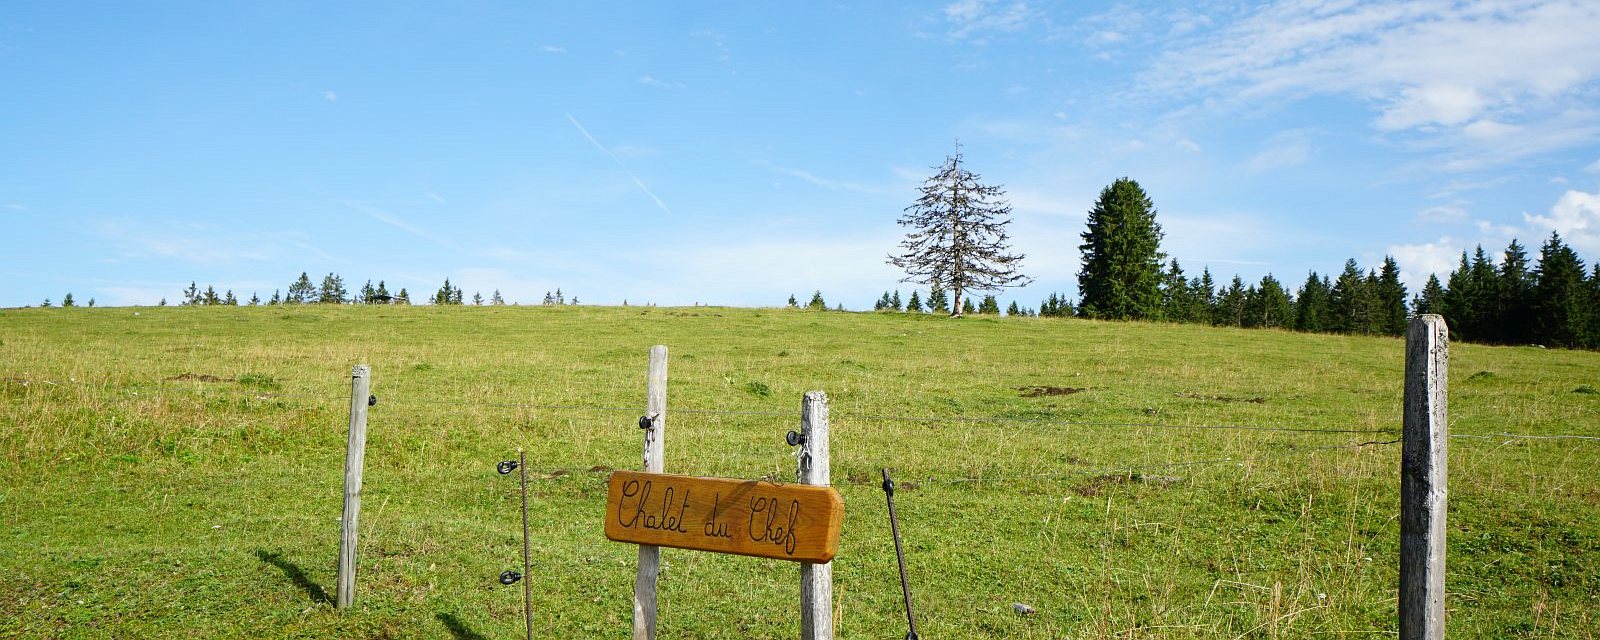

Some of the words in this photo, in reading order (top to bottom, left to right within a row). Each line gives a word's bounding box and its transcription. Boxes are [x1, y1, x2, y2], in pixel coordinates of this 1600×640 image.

[618, 480, 687, 533] Chalet
[704, 492, 732, 537] du
[749, 495, 799, 556] Chef
